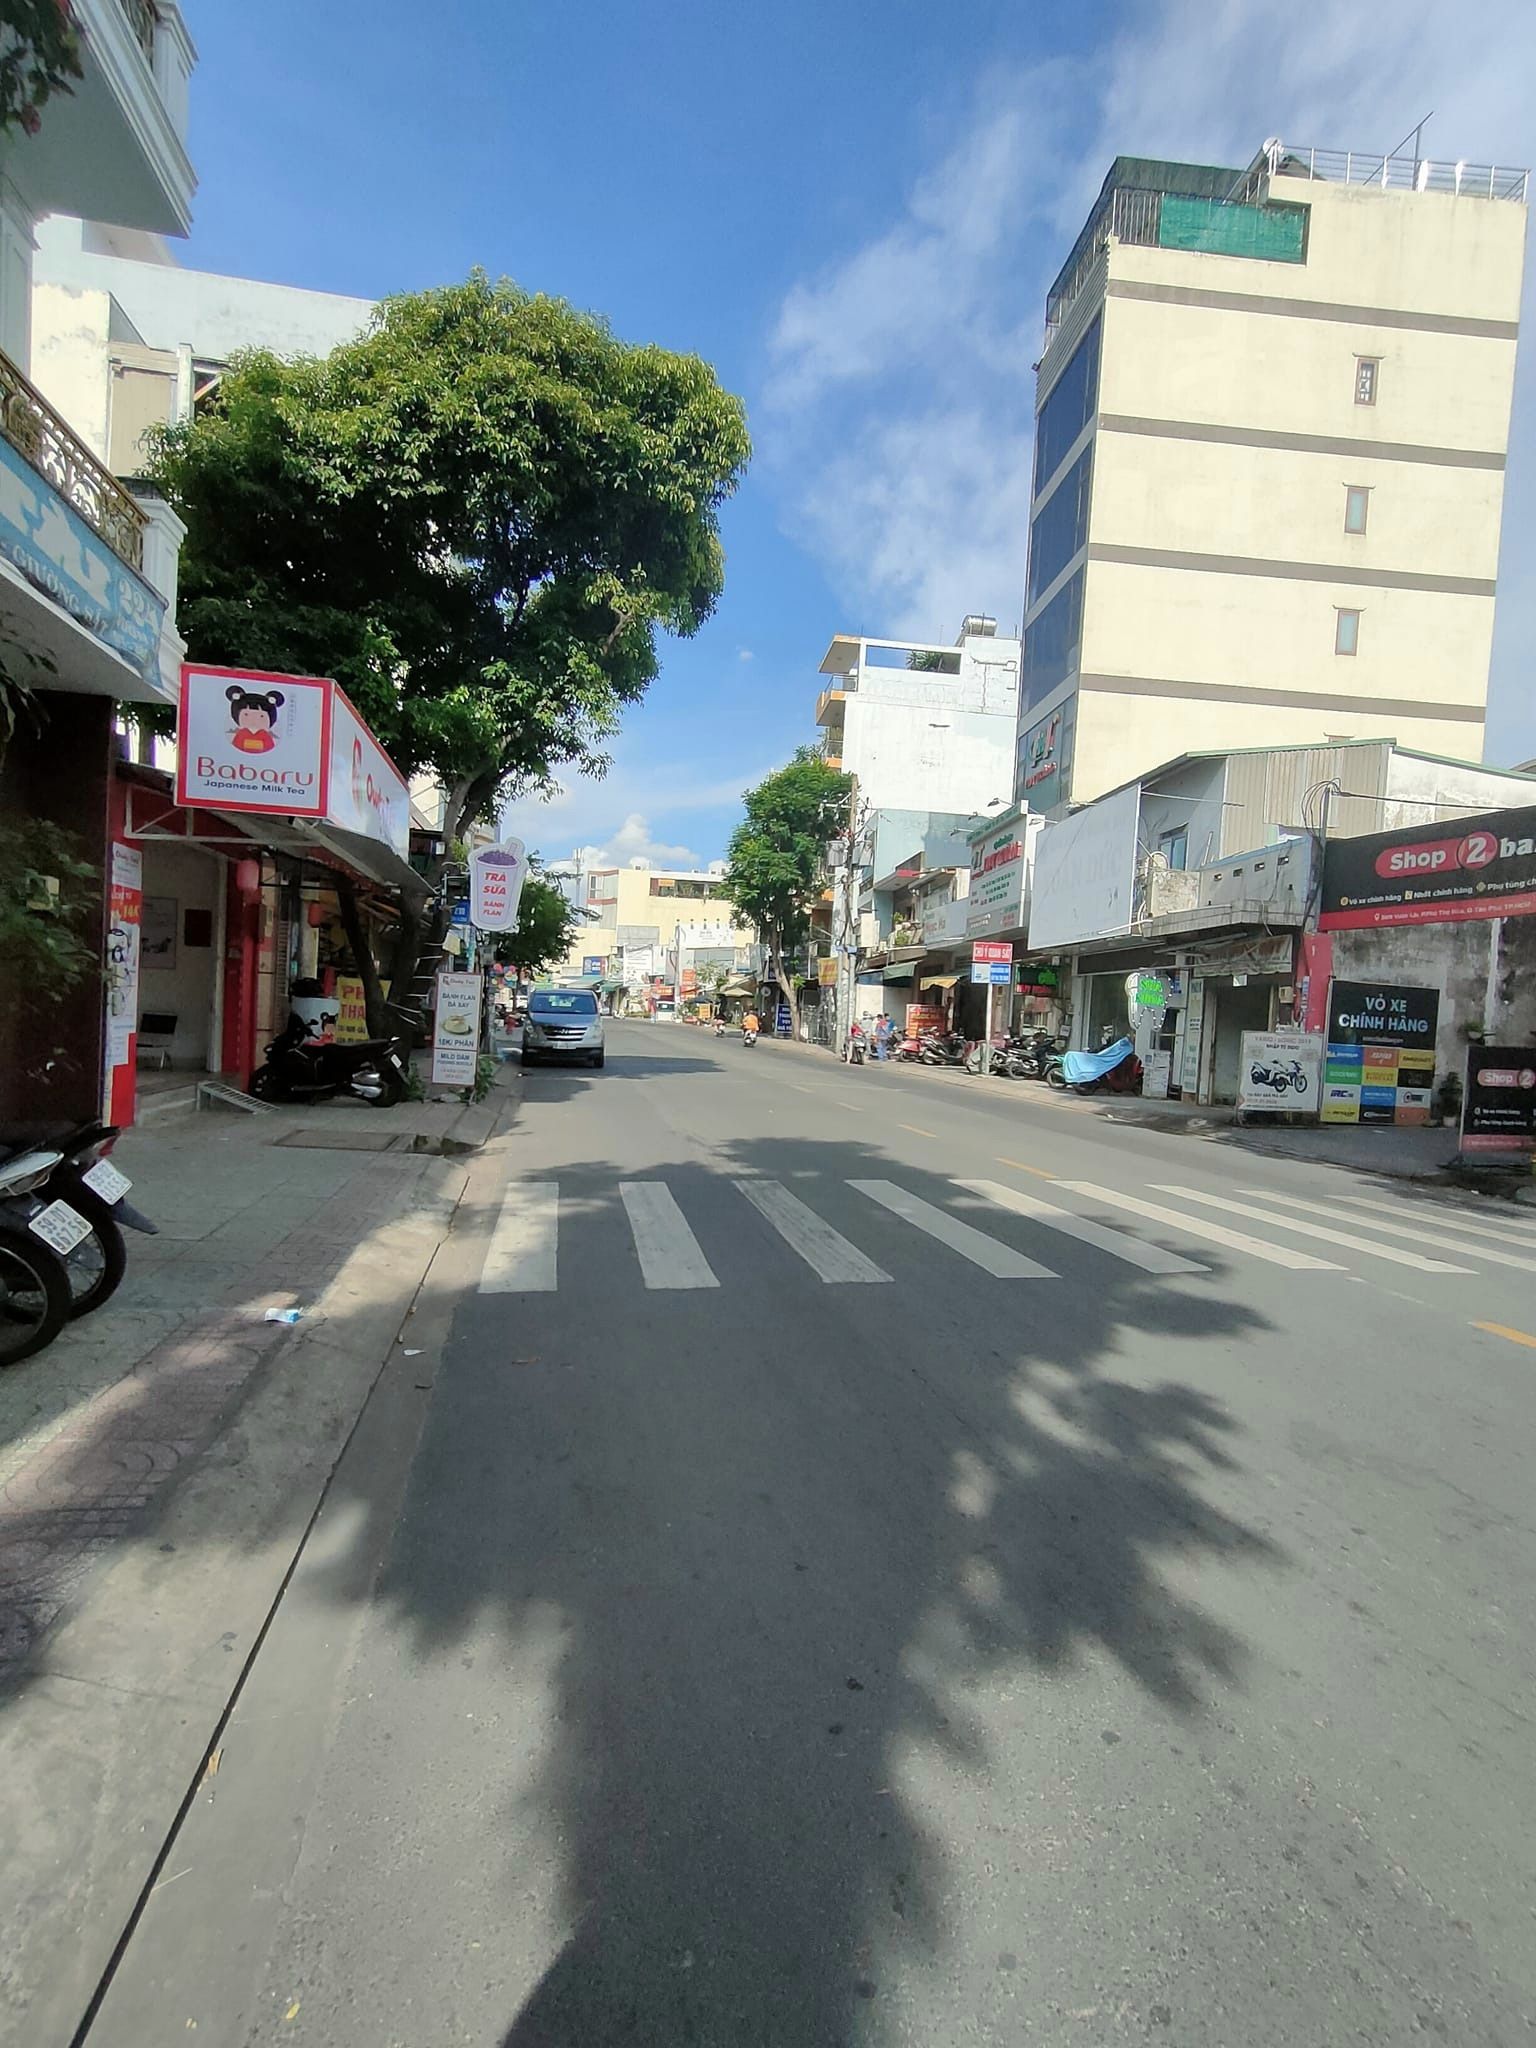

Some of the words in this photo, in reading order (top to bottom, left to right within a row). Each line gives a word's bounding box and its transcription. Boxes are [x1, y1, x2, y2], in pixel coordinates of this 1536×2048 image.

[197, 756, 313, 786] Babaru
[203, 779, 258, 791] Japanese
[261, 784, 283, 793] Milk
[287, 786, 305, 795] Tea
[1389, 850, 1447, 871] Shop
[1466, 836, 1487, 864] 2
[484, 871, 506, 882] TRÀ
[483, 883, 507, 895] SỮA
[1365, 993, 1386, 1011] VỎ
[1390, 999, 1407, 1012] XE
[1338, 1011, 1384, 1030] CHÍNH
[1484, 1072, 1513, 1084] Shop
